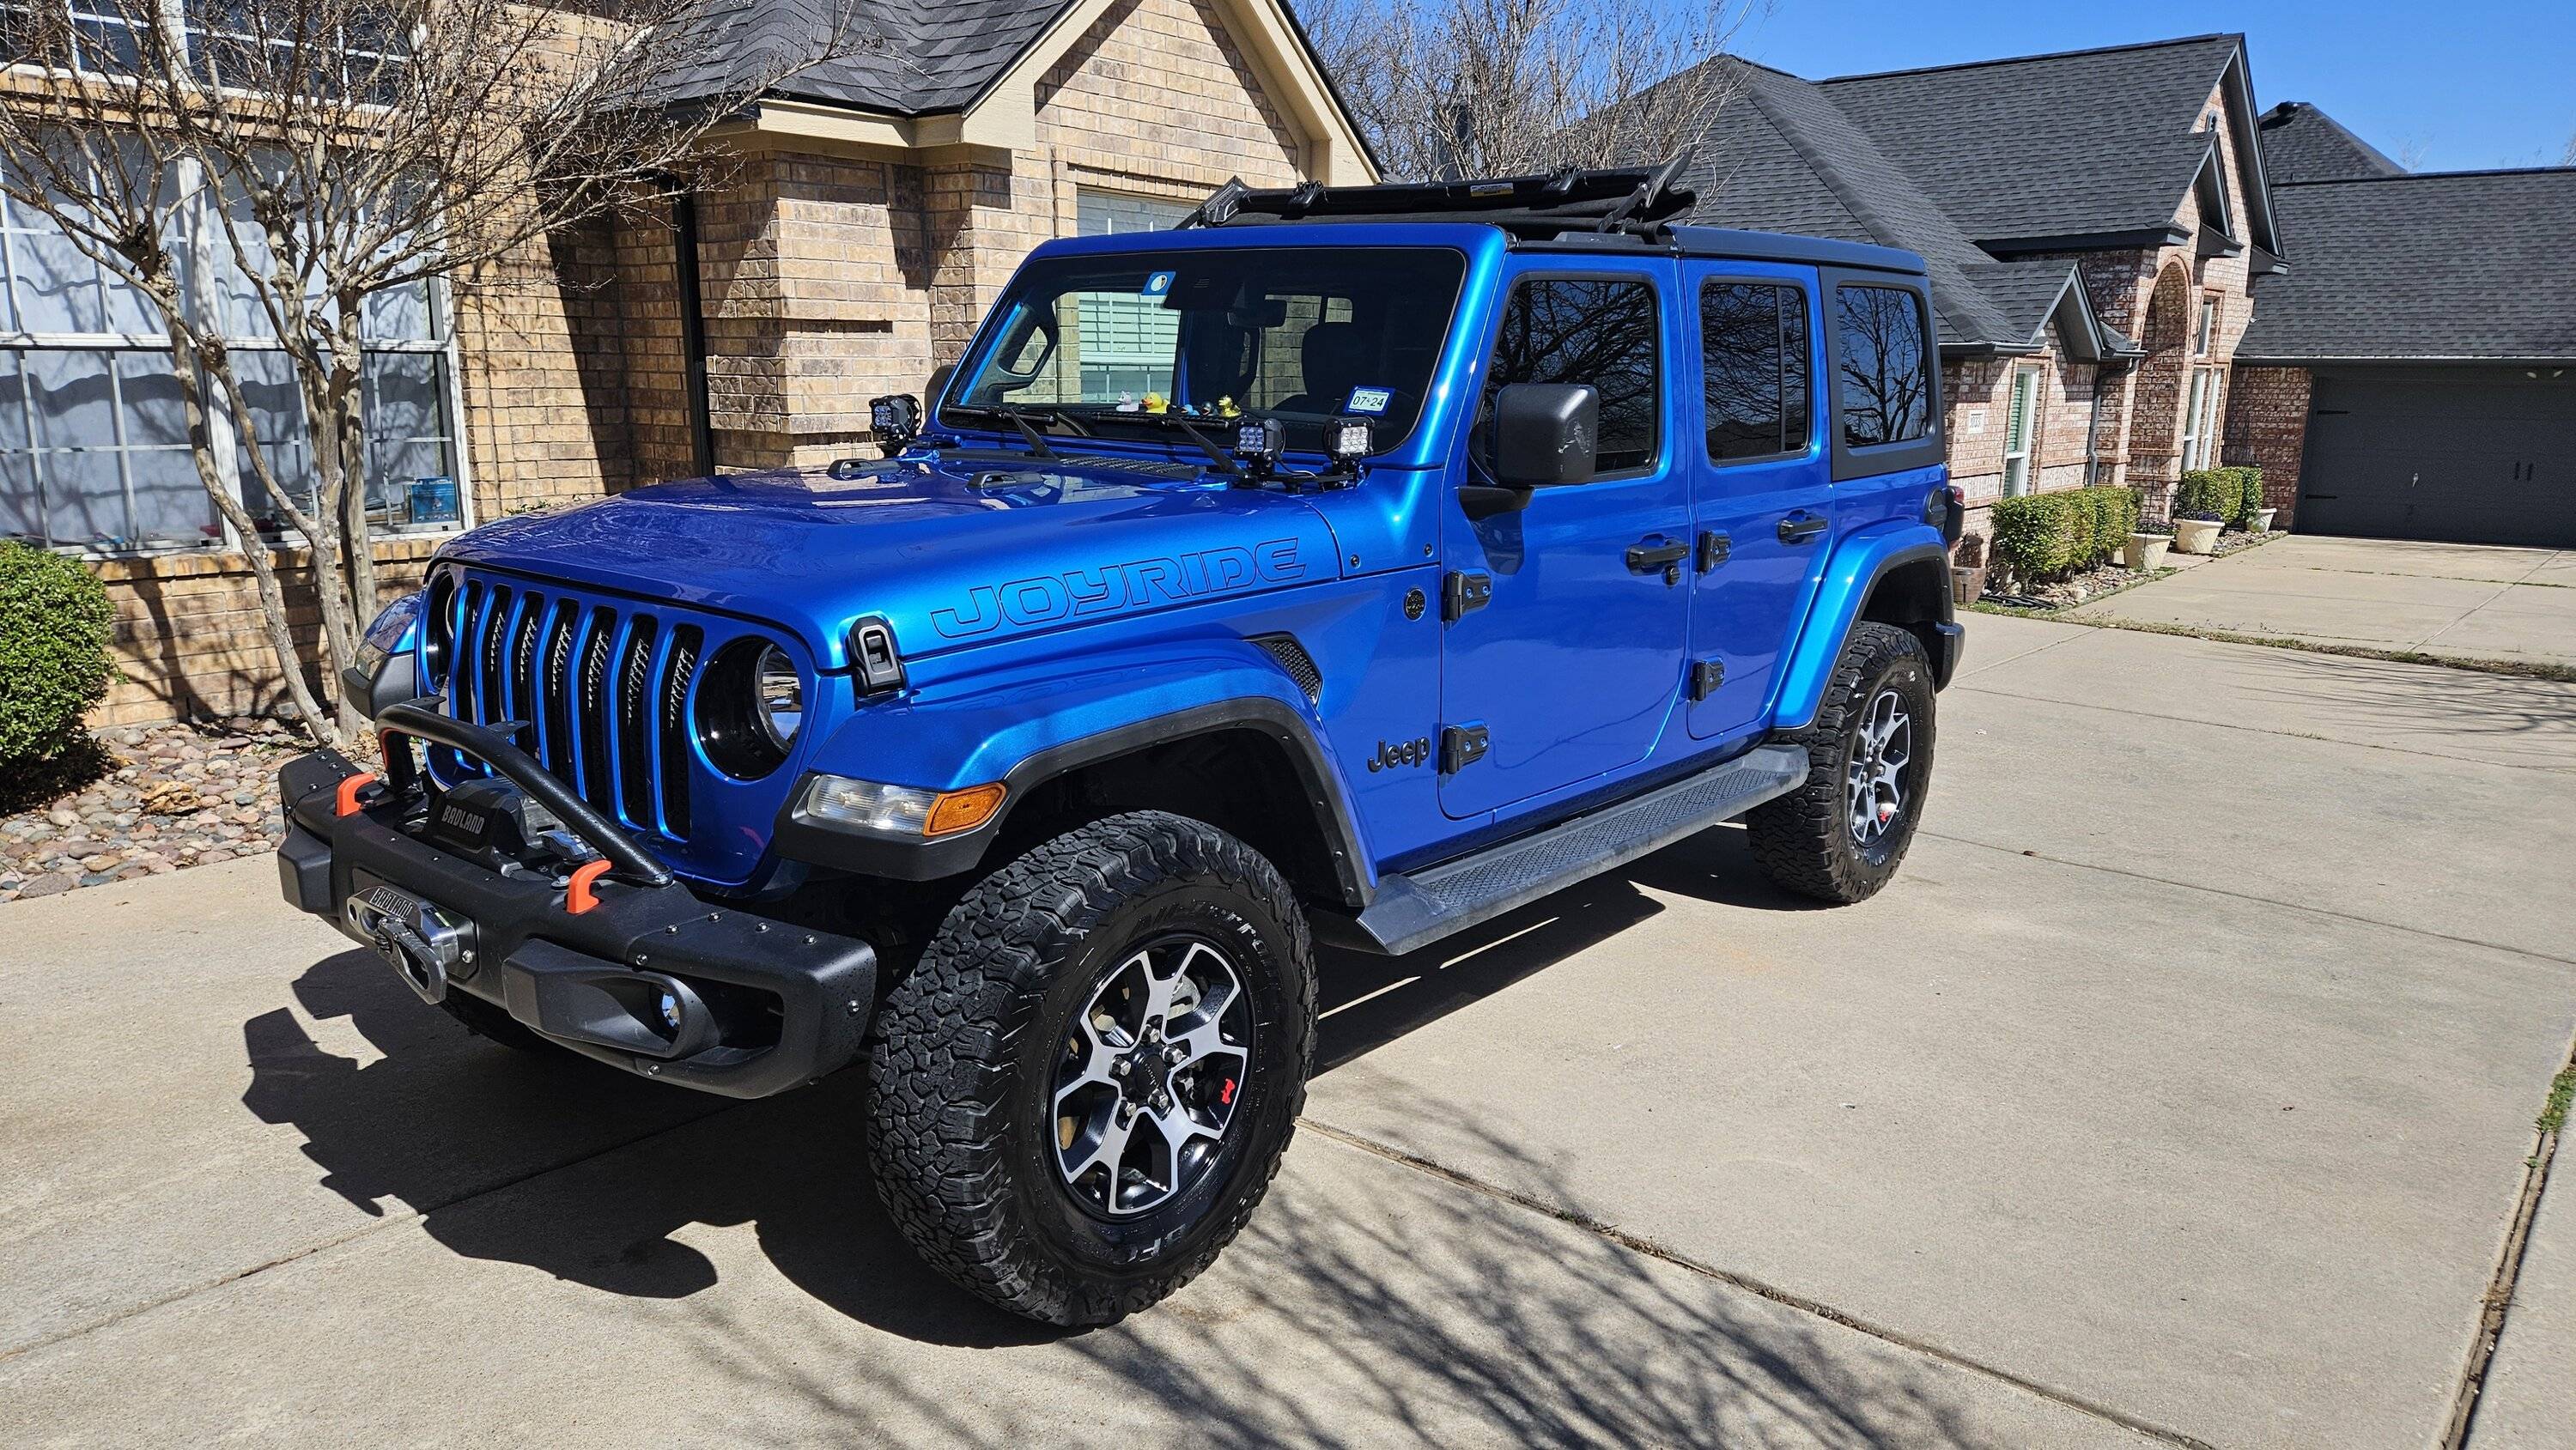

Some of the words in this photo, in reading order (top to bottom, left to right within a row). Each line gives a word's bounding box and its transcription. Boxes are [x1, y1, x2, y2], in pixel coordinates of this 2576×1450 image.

[930, 537, 1307, 638] JOYRIDE
[1367, 736, 1431, 773] Jeep
[441, 804, 485, 834] BADLAND
[369, 888, 413, 919] BADLAND
